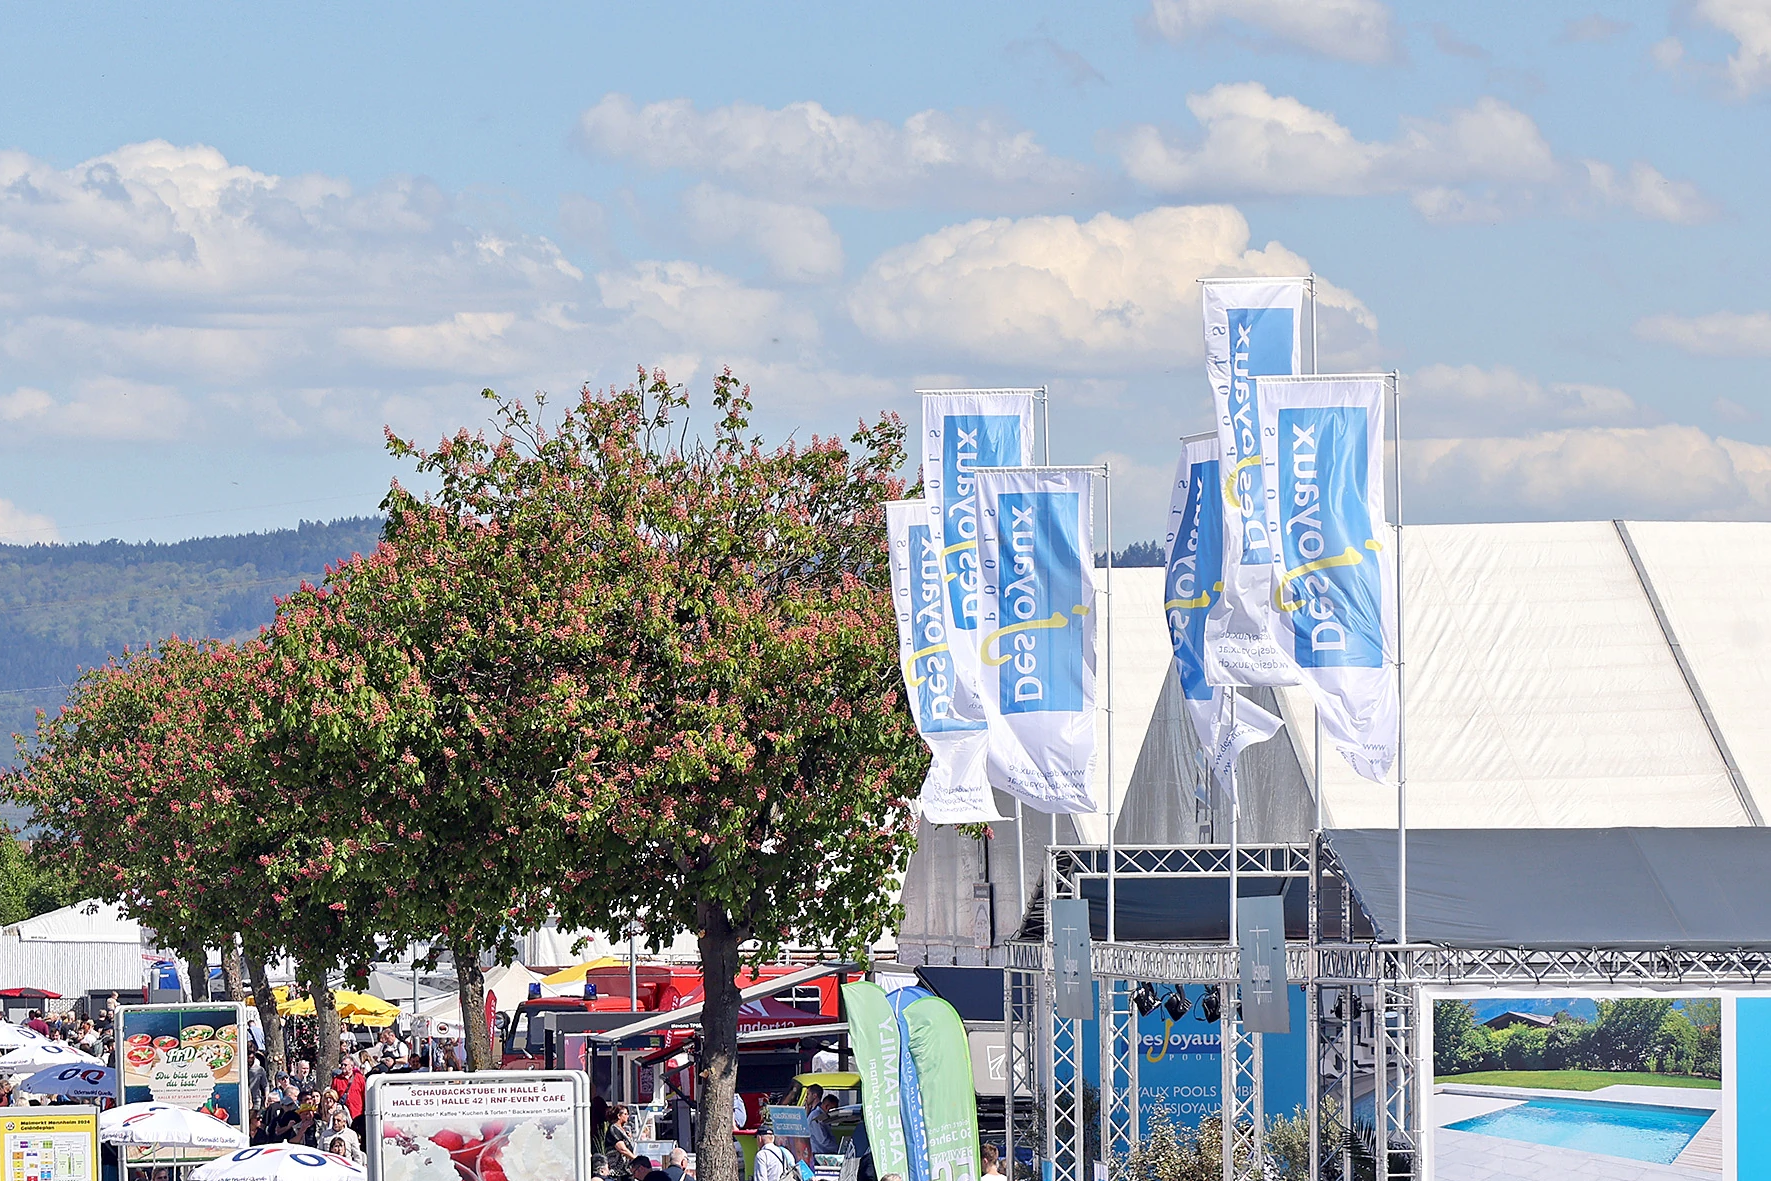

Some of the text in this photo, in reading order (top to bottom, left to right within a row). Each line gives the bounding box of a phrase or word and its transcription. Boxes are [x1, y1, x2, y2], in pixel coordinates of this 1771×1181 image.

[155, 1071, 170, 1080] Du
[172, 1071, 189, 1079] bist
[166, 1079, 177, 1087] du
[411, 1087, 496, 1097] SCHAUBACKSTUBE
[509, 1086, 539, 1094] HALLE
[1173, 1086, 1217, 1097] POOLS
[392, 1093, 566, 1107] HALLE 35 HALLE 42 RNF-EVENT CAFÉ
